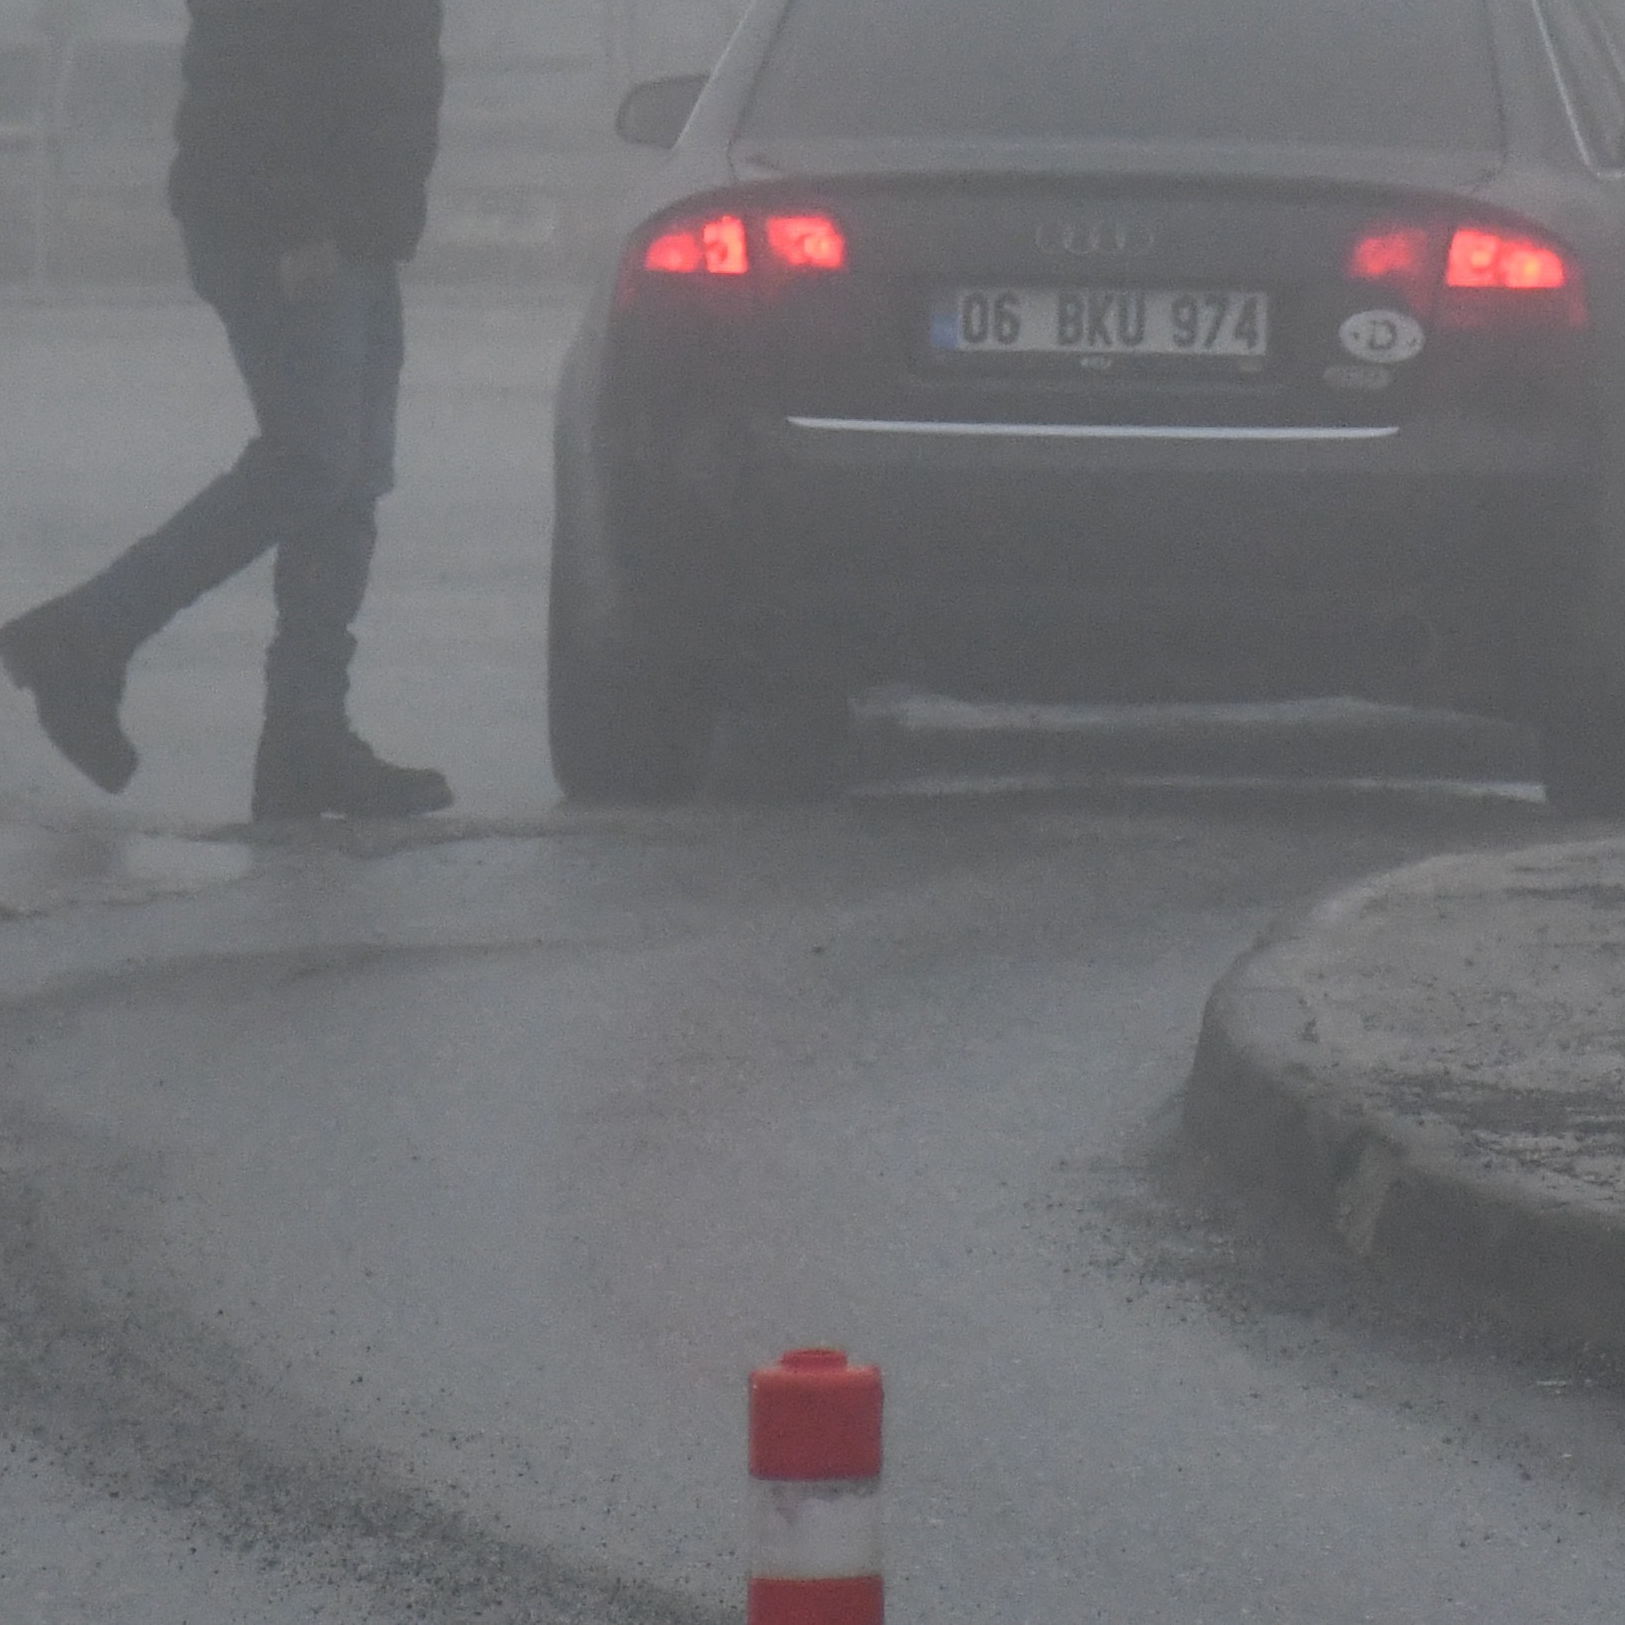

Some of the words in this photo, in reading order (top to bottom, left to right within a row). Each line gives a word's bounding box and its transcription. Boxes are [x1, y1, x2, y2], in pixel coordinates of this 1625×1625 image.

[961, 290, 1021, 345] 06
[1057, 291, 1146, 347] BKU
[1170, 293, 1258, 350] 974
